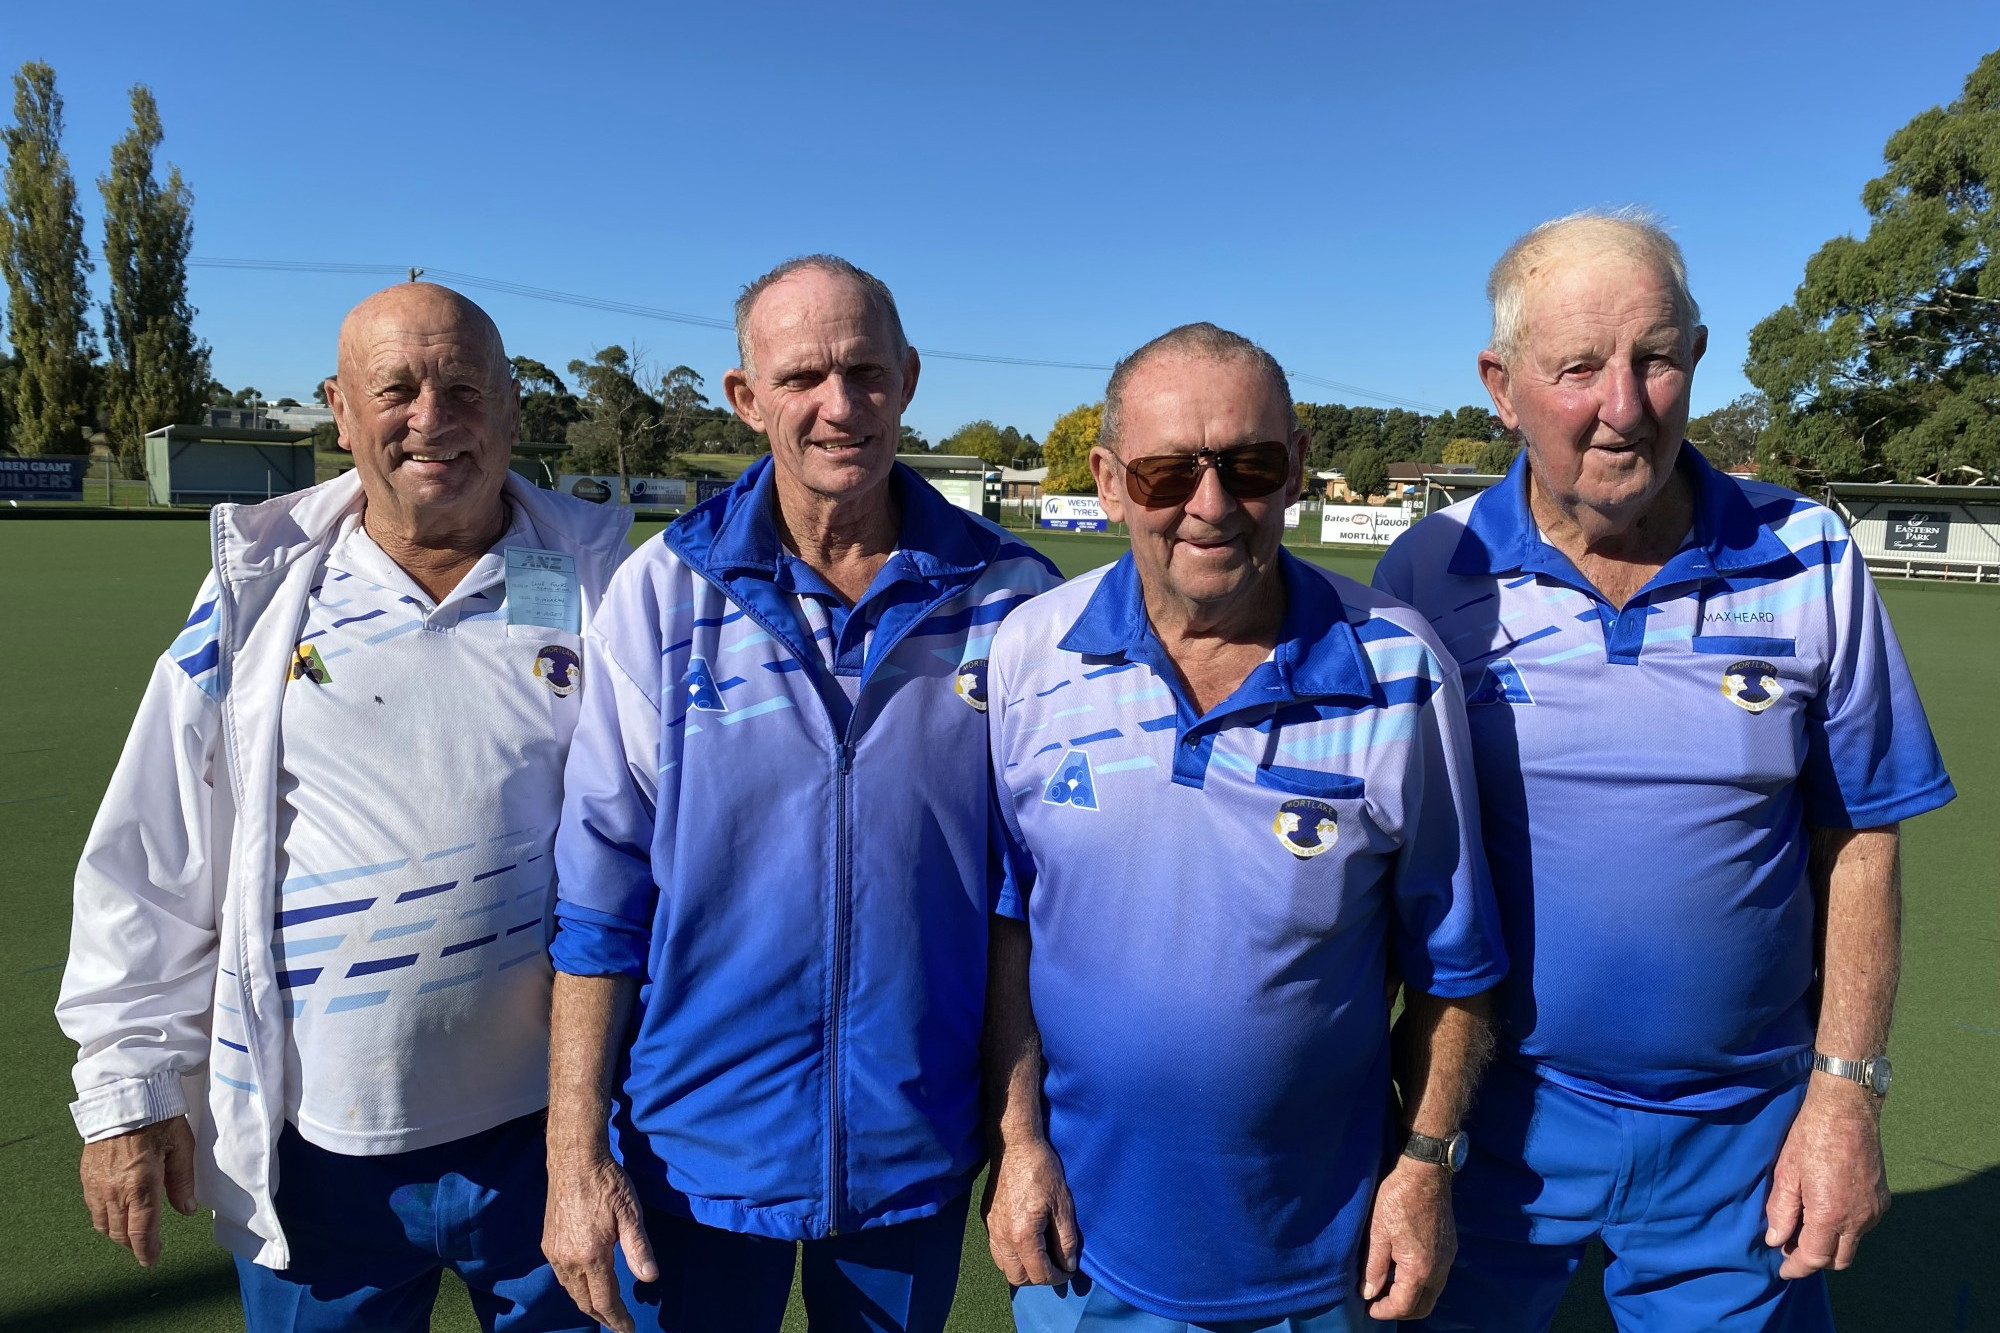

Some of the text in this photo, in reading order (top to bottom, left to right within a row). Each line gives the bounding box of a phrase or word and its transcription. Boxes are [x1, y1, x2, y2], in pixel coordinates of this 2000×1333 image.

[30, 462, 72, 472] GRANT
[1067, 499, 1101, 508] WESTVI
[1072, 508, 1099, 517] TYRES
[1324, 514, 1351, 523] Bates
[1375, 518, 1409, 528] LIQUOR
[1895, 524, 1940, 534] EASTERN
[1339, 532, 1390, 541] MORTLAKE
[1905, 532, 1931, 541] PARK
[521, 554, 563, 570] ANZ
[1703, 611, 1775, 623] MAX HEARD
[962, 660, 988, 672] MORTL
[1730, 661, 1776, 674] MORTLAKE
[1285, 799, 1334, 817] MORTLAKE
